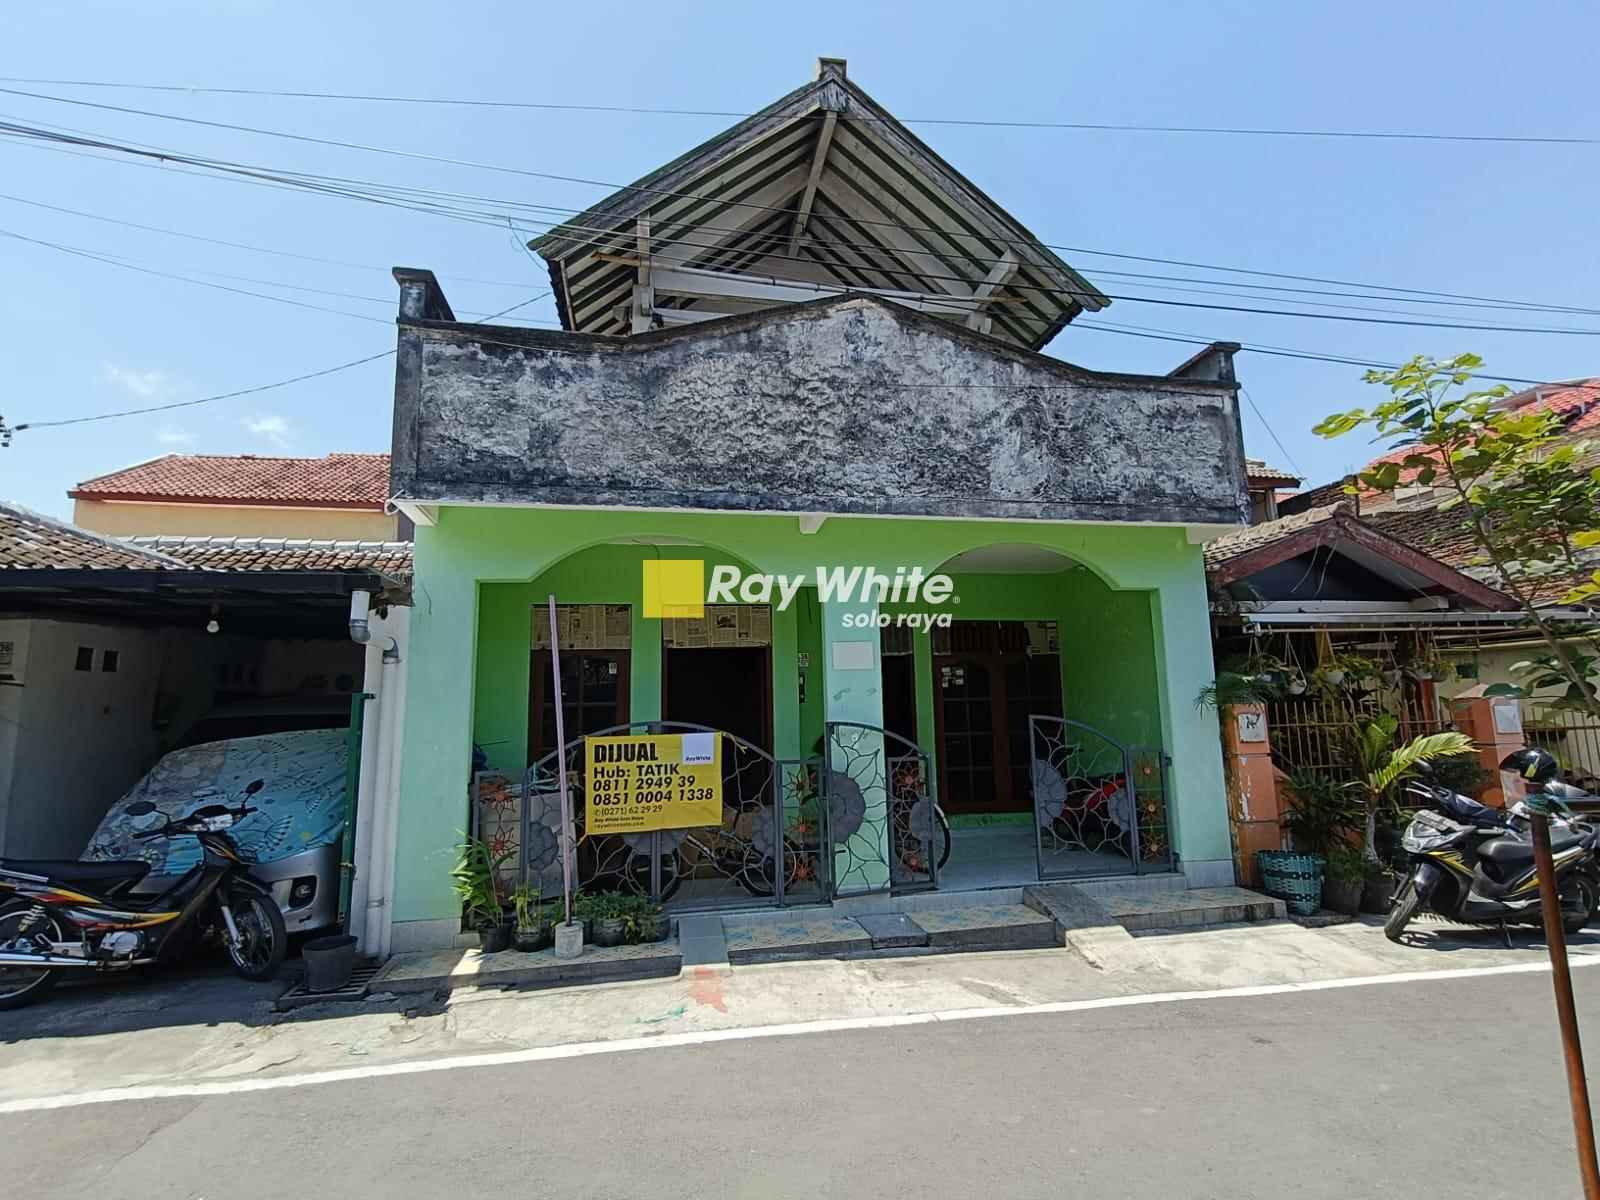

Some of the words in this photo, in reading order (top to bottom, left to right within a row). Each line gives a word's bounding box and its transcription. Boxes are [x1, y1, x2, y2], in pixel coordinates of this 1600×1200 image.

[594, 743, 658, 763] DIJUAL
[593, 766, 631, 779] Hub:
[636, 763, 680, 776] TATIK
[593, 779, 629, 792] 0811
[636, 776, 673, 790] 2949
[678, 775, 696, 788] 39
[593, 793, 629, 806] 0851
[636, 790, 673, 804] 0004
[680, 788, 713, 801] 1338
[601, 807, 627, 816] (0271)
